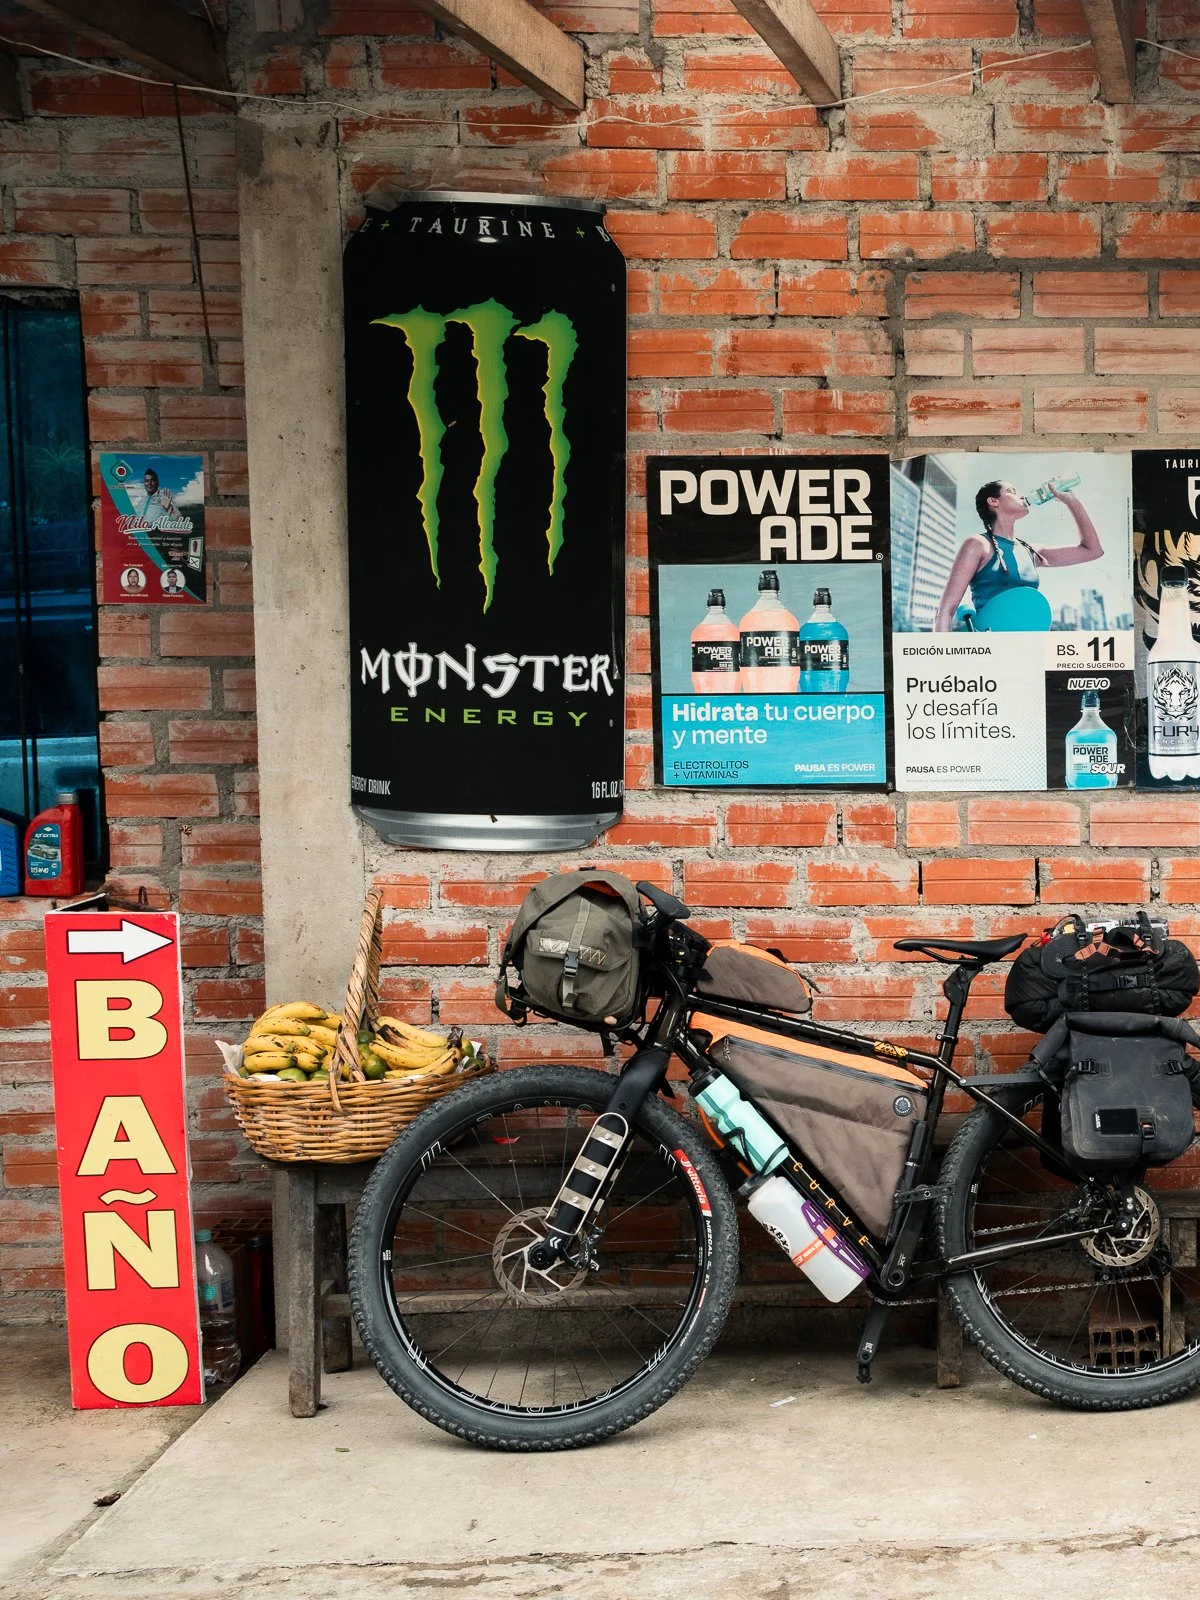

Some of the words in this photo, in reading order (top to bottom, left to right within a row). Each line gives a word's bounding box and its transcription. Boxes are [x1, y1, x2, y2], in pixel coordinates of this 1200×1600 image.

[409, 216, 556, 239] TAURINE
[659, 469, 872, 516] POWER
[116, 515, 150, 532] Nilo
[151, 515, 194, 530] Alcalde
[759, 515, 873, 561] ADE
[697, 646, 732, 654] POWER
[746, 636, 790, 647] POWER
[804, 644, 841, 654] POWER
[1056, 645, 1079, 656] BS.
[1087, 636, 1116, 662] 11
[765, 647, 790, 657] ADE
[820, 653, 842, 662] ADE
[902, 645, 944, 656] EDICIÓN
[946, 646, 992, 656] LIMITADA
[360, 641, 615, 698] MONSTER
[906, 675, 997, 693] Pruébalo
[1068, 678, 1110, 690] NUEVO
[390, 706, 588, 727] ENERGY
[673, 702, 758, 722] Hidrata
[764, 703, 787, 721] tu
[794, 704, 875, 725] cuerpo
[906, 702, 918, 720] y
[923, 697, 998, 717] desafía
[672, 730, 686, 749] y
[692, 726, 768, 745] mente
[907, 722, 936, 739] los
[942, 721, 1016, 739] límites.
[1153, 725, 1199, 741] FURY
[1073, 746, 1109, 755] POWER
[1089, 755, 1109, 763] ADE
[673, 760, 749, 770] ELECTROLITOS
[794, 764, 826, 772] PAUSA
[827, 763, 840, 772] ES
[841, 763, 875, 772] POWER
[906, 765, 935, 774] PAUSA
[937, 765, 948, 773] ES
[950, 765, 982, 773] POWER
[1090, 763, 1126, 774] SOUR
[683, 769, 739, 780] VITAMINAS
[368, 779, 391, 796] DRINK
[591, 781, 601, 799] 16
[74, 979, 190, 1404] BAÑO
[687, 1167, 706, 1204] vittoria
[793, 1161, 869, 1247] CURVE
